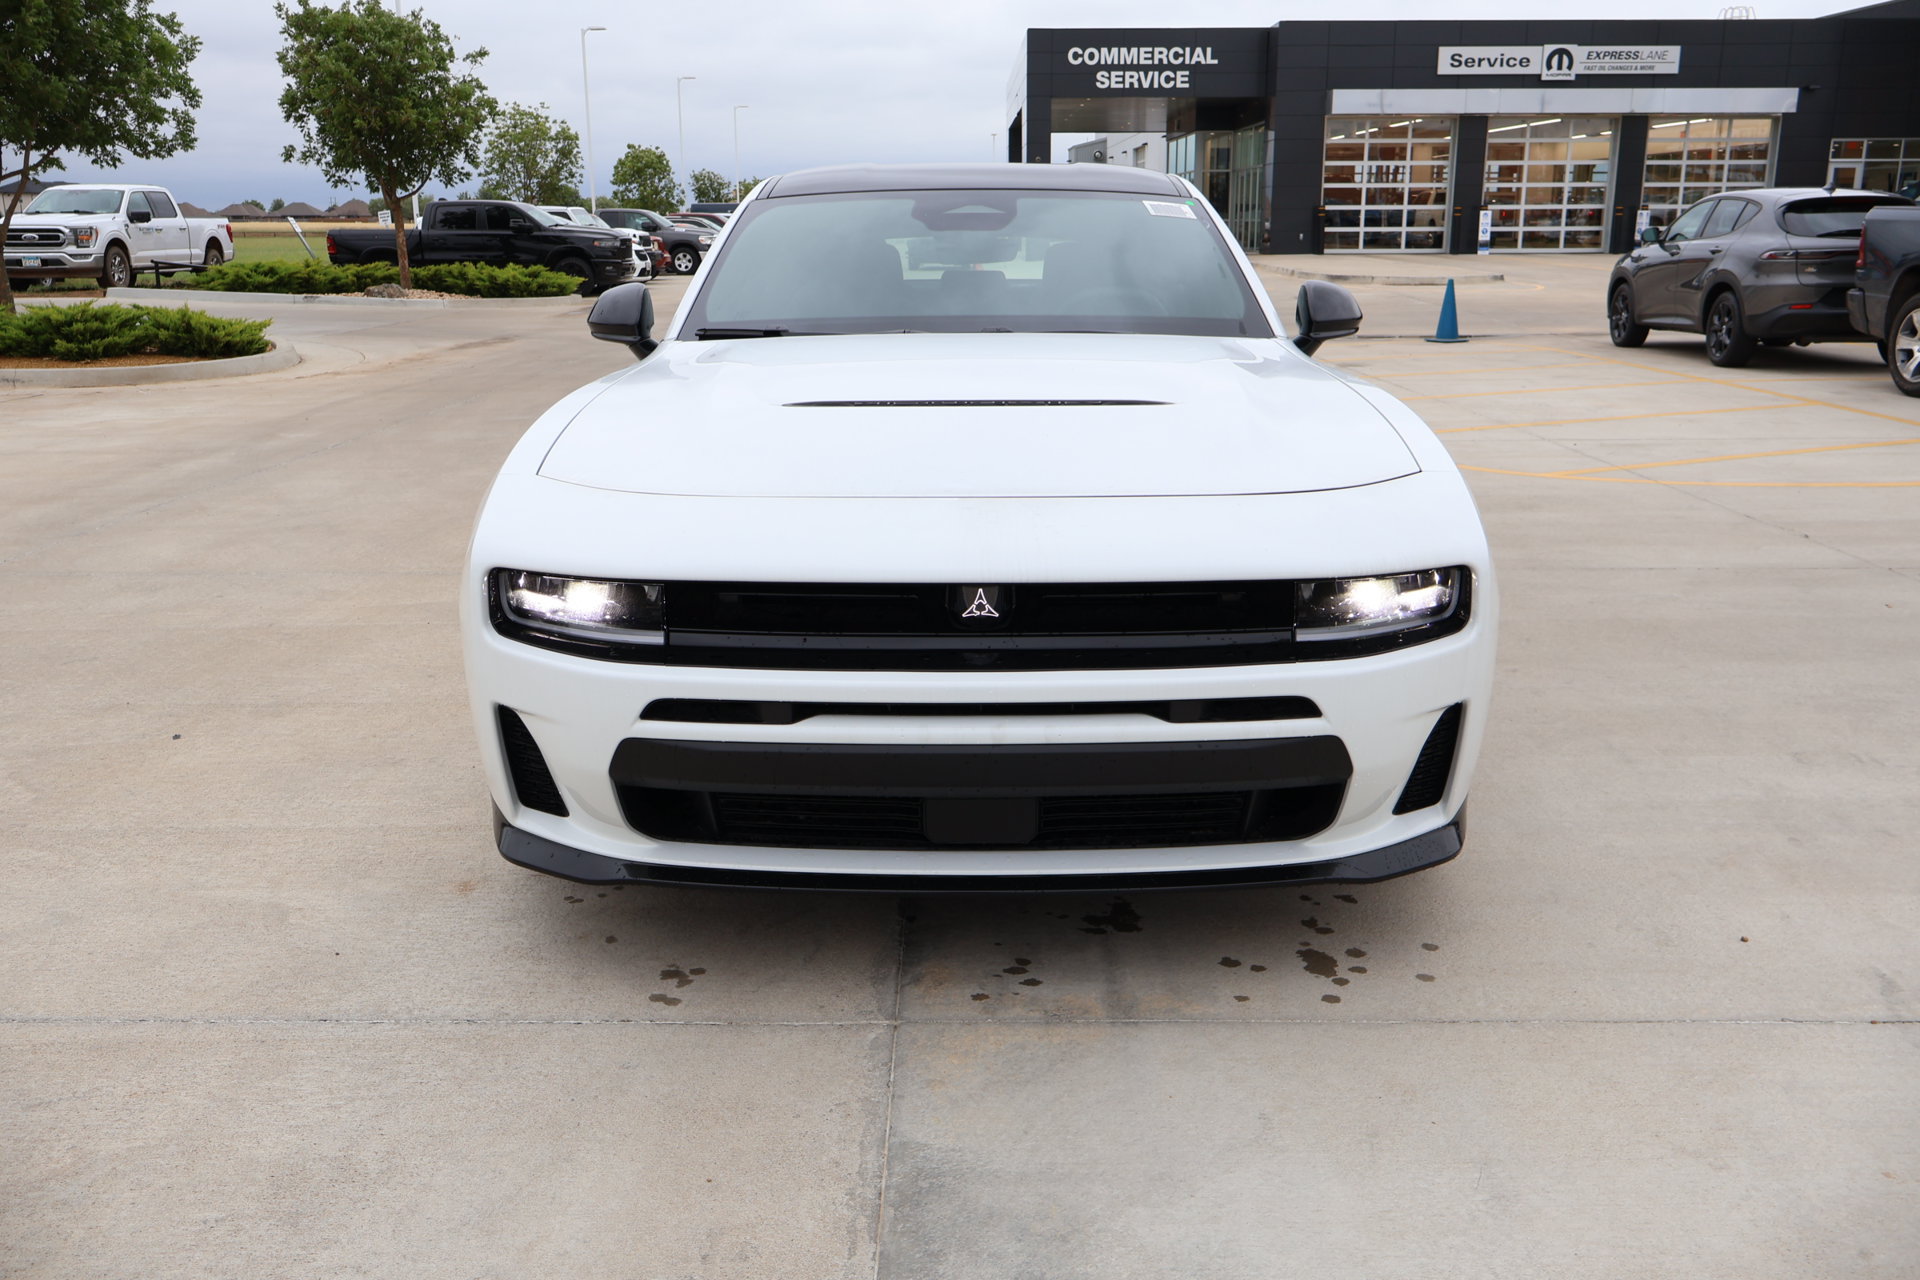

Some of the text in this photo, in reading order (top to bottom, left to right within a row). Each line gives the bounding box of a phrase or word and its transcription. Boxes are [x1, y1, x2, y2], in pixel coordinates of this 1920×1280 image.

[1067, 46, 1219, 66] COMMERCIAL
[1449, 53, 1531, 68] Service
[1095, 70, 1190, 89] SERVICE
